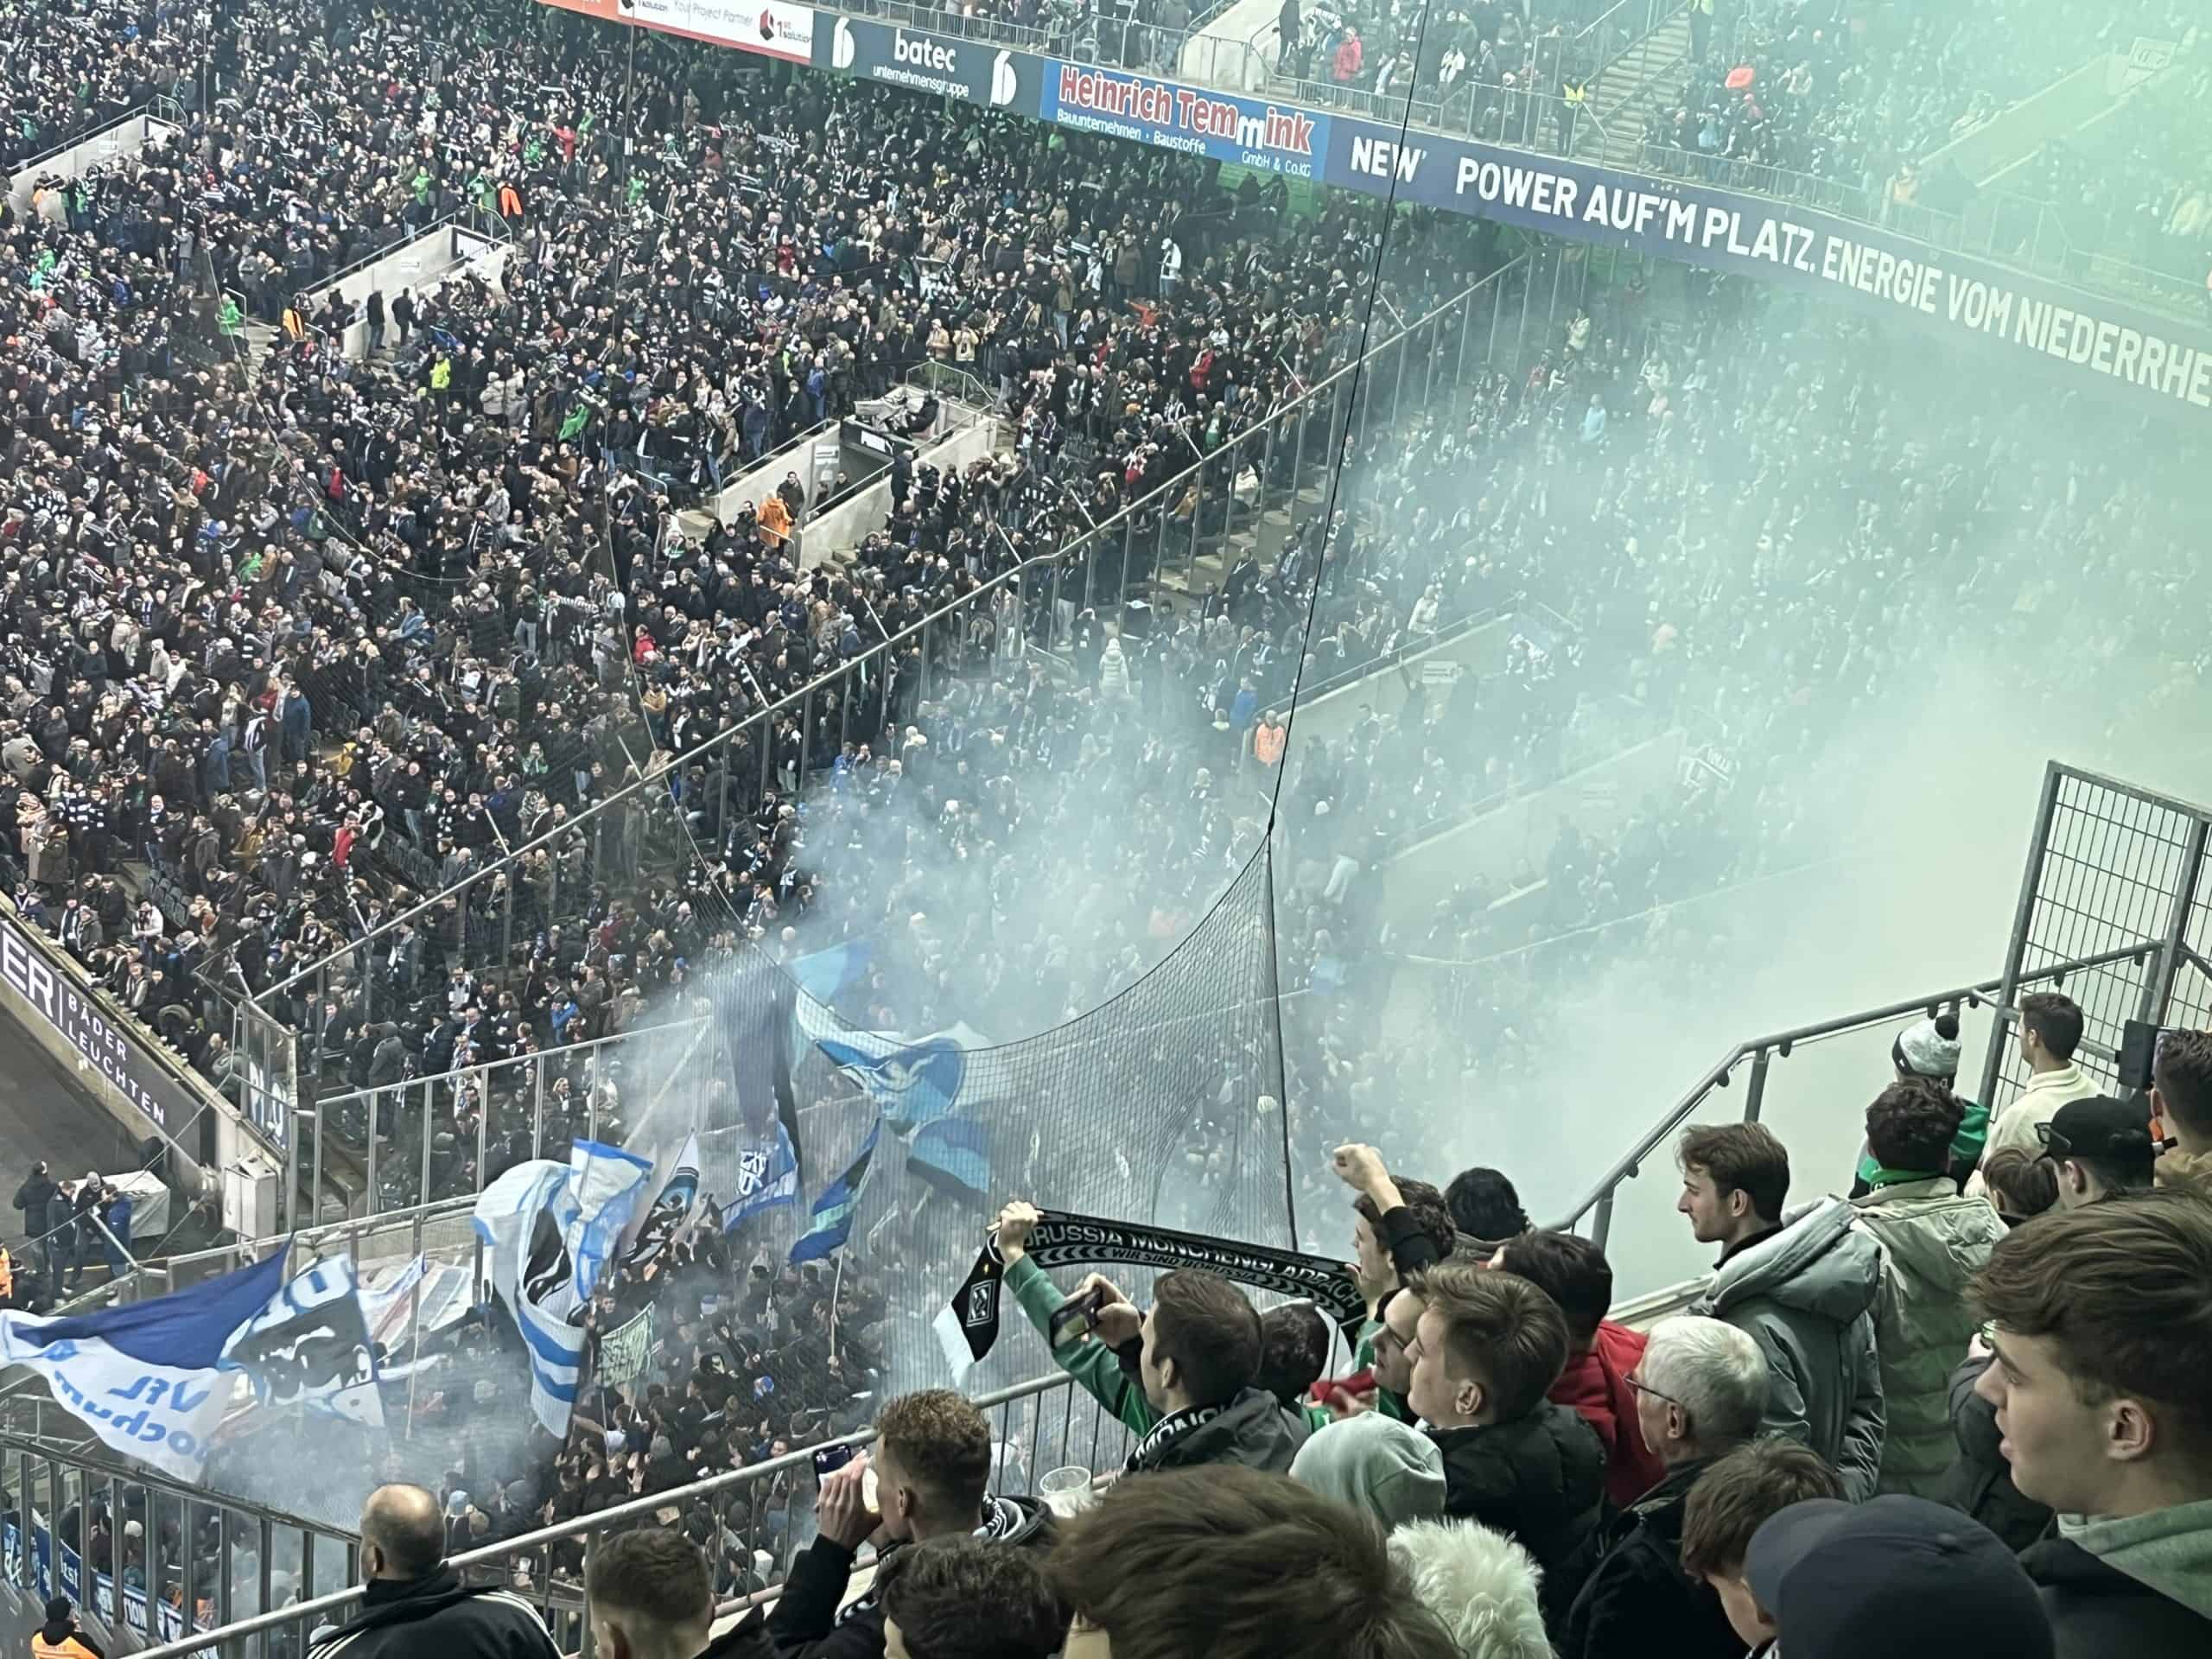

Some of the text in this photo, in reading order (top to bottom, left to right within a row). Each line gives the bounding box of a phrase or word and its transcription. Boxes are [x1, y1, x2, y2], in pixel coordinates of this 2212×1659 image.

[894, 28, 957, 73] batec
[873, 65, 969, 98] unternehmensgruppe
[1057, 109, 1206, 155] Bauunternehmen Baustoffe
[1059, 65, 1316, 156] Heinrich Temmink
[1242, 150, 1270, 168] GmbH
[1456, 156, 1578, 219] POWER
[1821, 235, 1942, 315] ENERGIE
[1948, 273, 2013, 338] VOM
[68, 992, 127, 1061] BÄDER
[68, 1020, 164, 1124] LEUCHTEN
[1143, 1253, 1179, 1266] SIND
